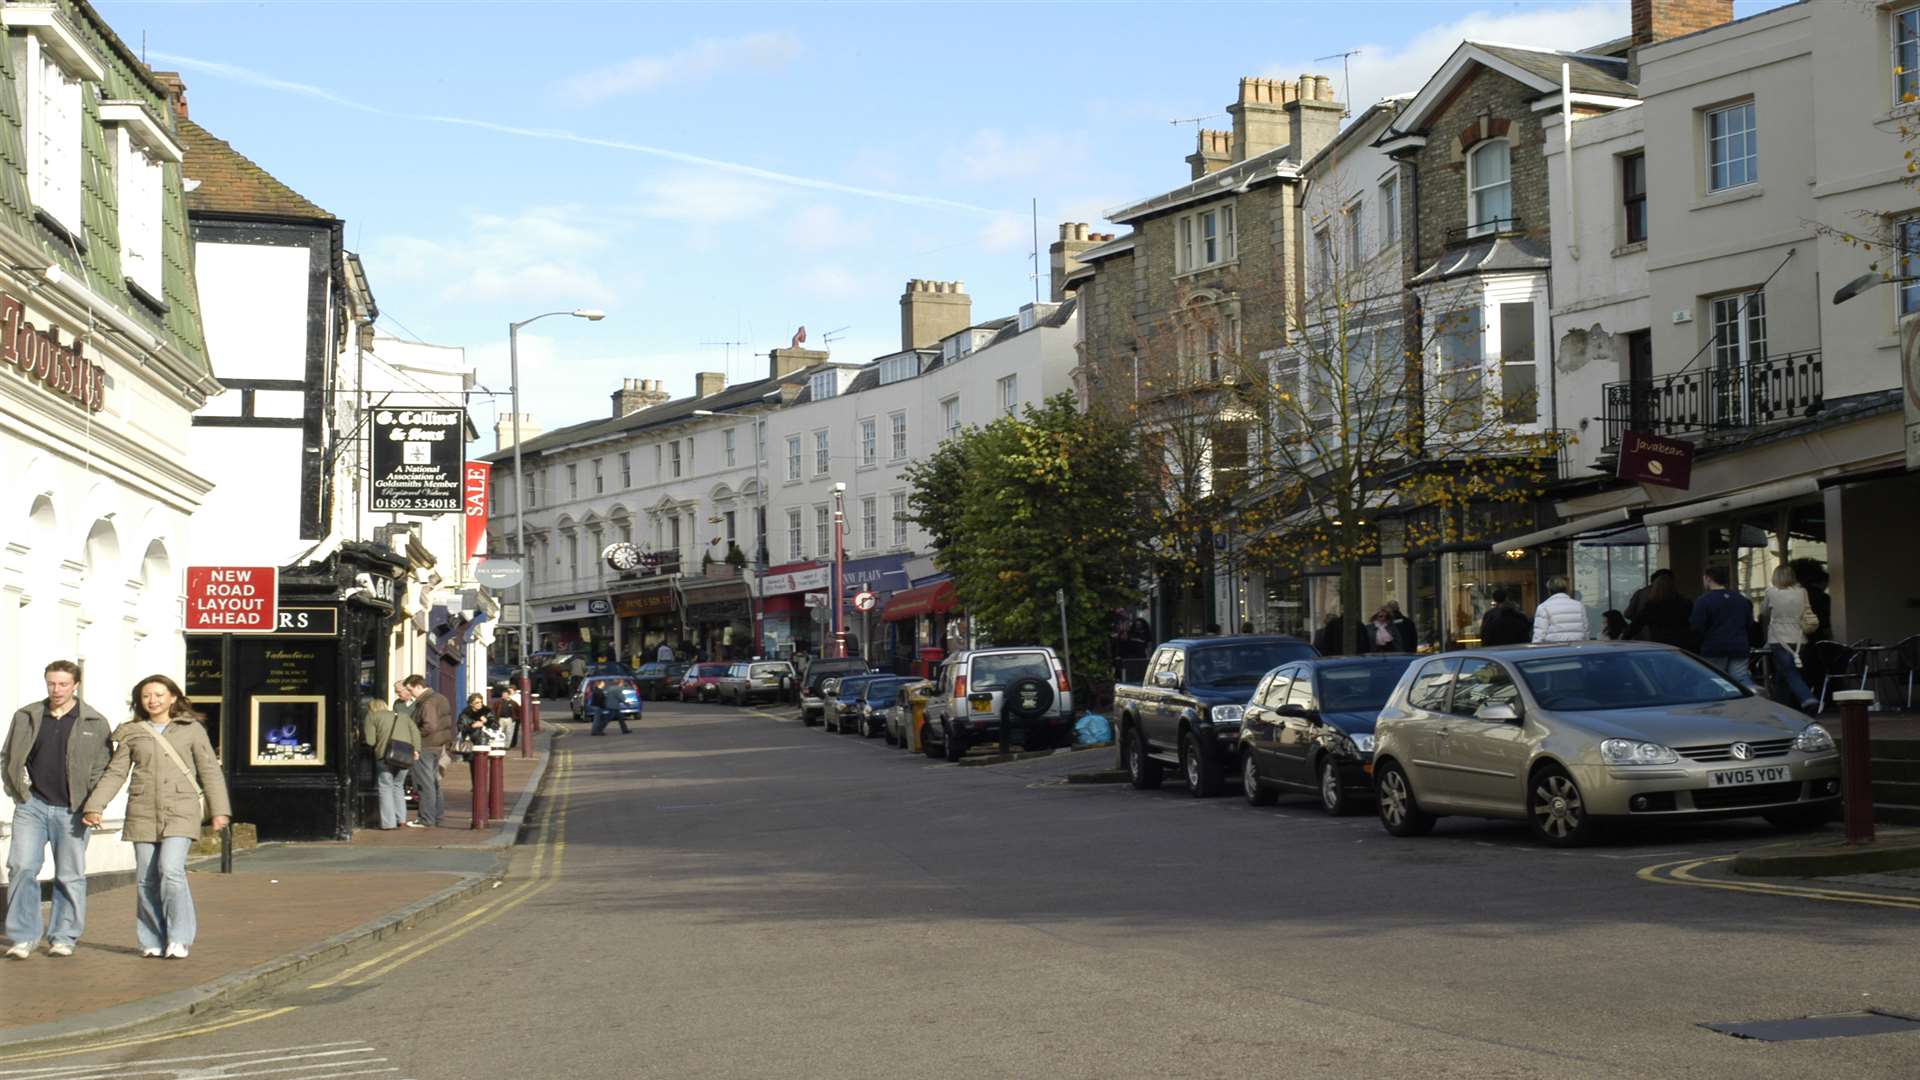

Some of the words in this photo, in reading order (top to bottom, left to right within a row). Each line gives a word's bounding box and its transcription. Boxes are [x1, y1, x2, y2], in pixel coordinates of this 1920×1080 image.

[398, 411, 458, 425] Collins
[389, 427, 407, 441] &
[407, 427, 446, 441] Sons
[1631, 438, 1685, 457] Javabean
[394, 465, 402, 473] A
[404, 465, 440, 473] National
[375, 480, 422, 488] Goldsmiths
[423, 480, 459, 488] Member
[466, 468, 486, 517] SALE
[376, 499, 411, 508] 01892
[414, 499, 457, 508] 534018
[211, 570, 252, 582] NEW
[206, 584, 255, 596] ROAD
[198, 598, 264, 610] LAYOUT
[199, 612, 260, 624] AHEAD
[279, 612, 308, 628] RS
[1715, 769, 1754, 785] WV05
[1758, 767, 1785, 782] YOY
